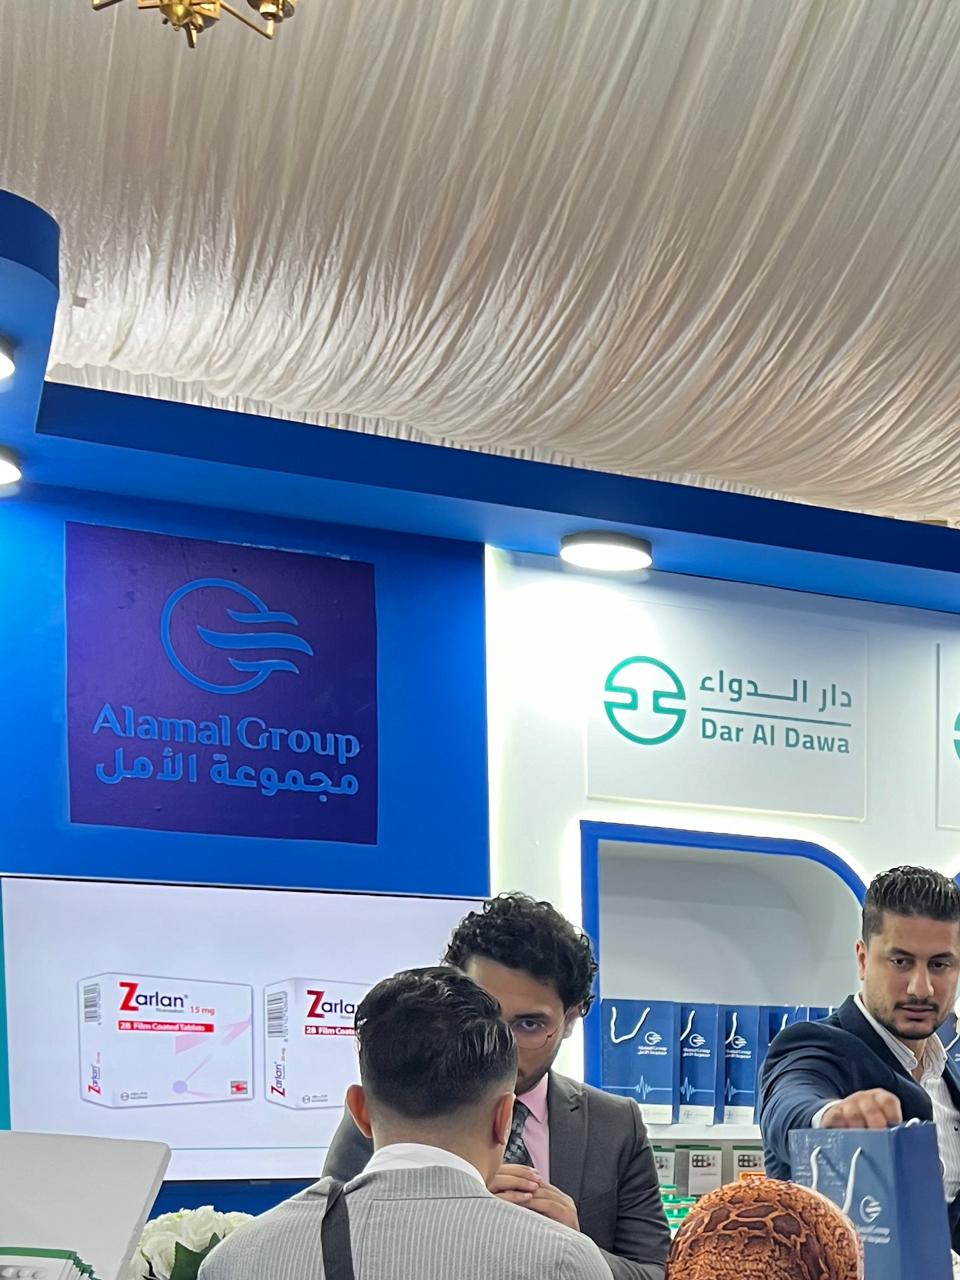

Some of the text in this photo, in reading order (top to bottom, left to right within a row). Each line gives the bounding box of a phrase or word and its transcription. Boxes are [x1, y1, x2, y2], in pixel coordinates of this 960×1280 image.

[819, 683, 852, 712] دار
[93, 703, 361, 765] Alamal Group
[701, 717, 850, 754] Dar Al Dawa
[209, 753, 360, 802] مجموعة
[190, 1005, 200, 1014] 15
[201, 1007, 215, 1016] mg
[306, 989, 356, 1019] Zarla
[120, 1022, 131, 1030] 28
[133, 1022, 151, 1030] Film
[306, 1026, 316, 1034] 28
[318, 1026, 335, 1035] Film
